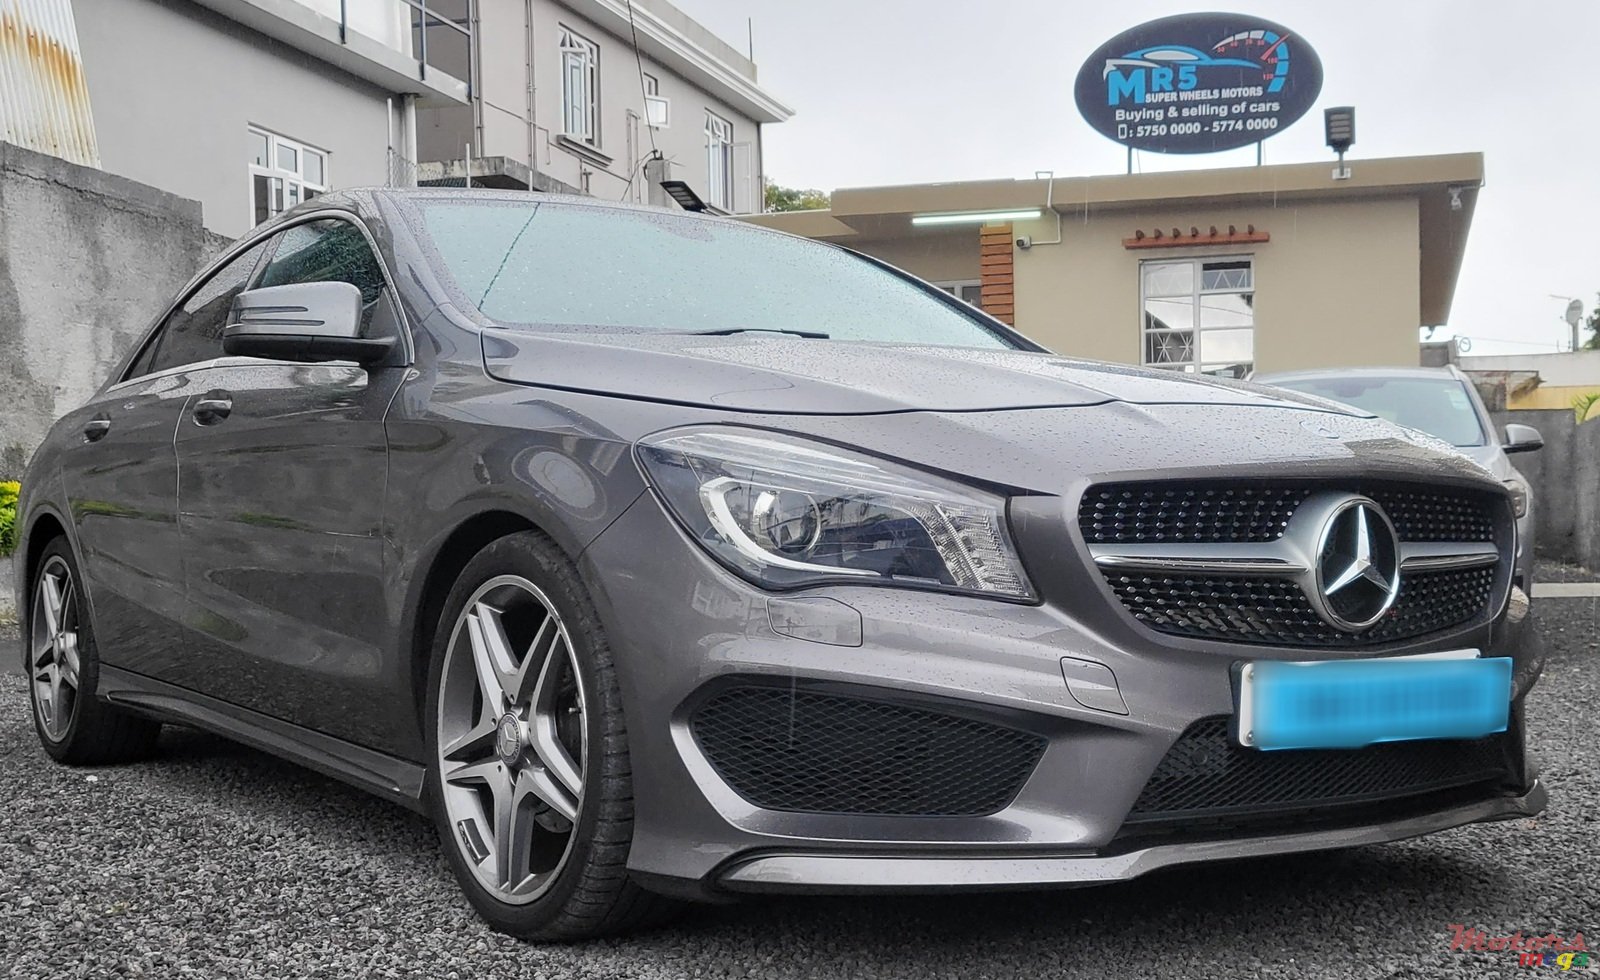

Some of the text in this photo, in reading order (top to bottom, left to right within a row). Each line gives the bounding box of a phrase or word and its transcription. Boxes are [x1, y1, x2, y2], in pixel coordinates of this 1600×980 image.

[1145, 86, 1263, 103] SUPER WHEELS MOTORS
[1115, 101, 1280, 122] Buying & selling of cars
[1136, 124, 1167, 137] 5750
[1170, 122, 1201, 135] 0000
[1212, 119, 1243, 132] 5774
[1246, 117, 1278, 130] 0000
